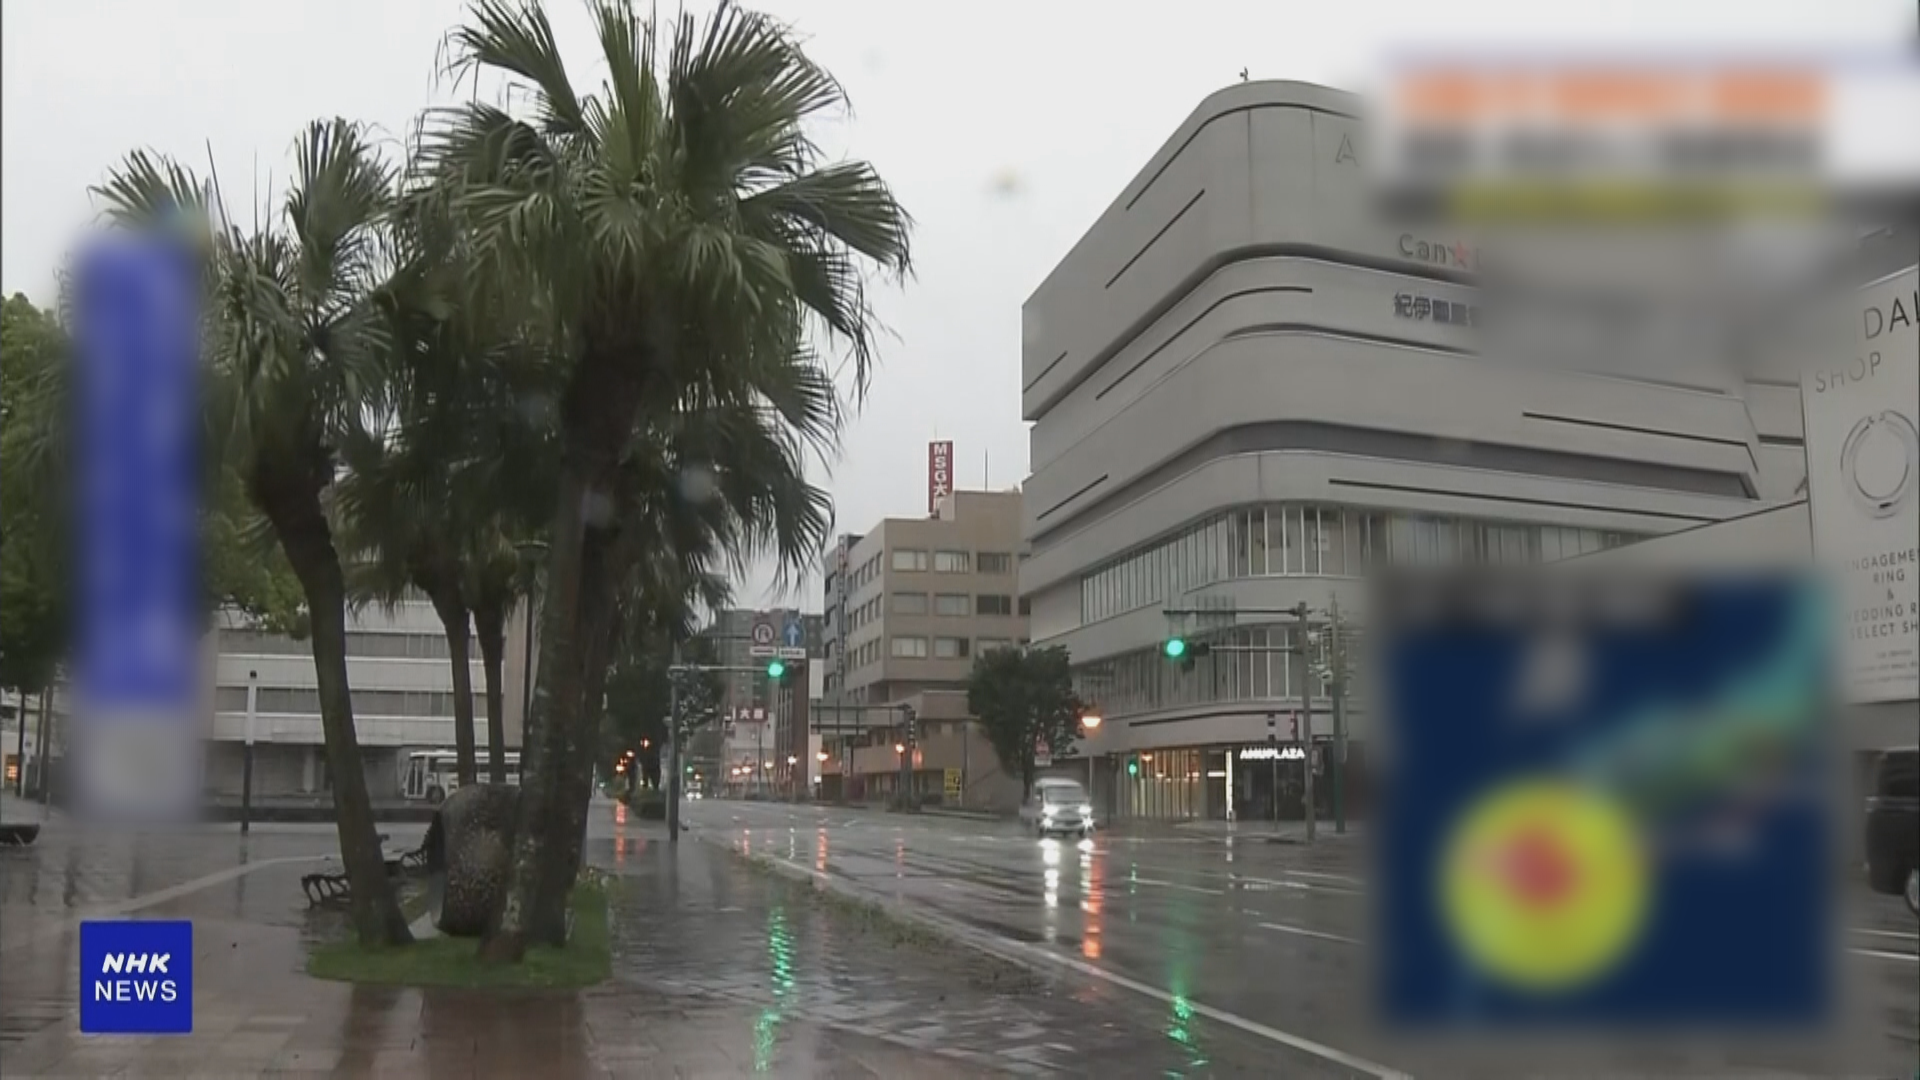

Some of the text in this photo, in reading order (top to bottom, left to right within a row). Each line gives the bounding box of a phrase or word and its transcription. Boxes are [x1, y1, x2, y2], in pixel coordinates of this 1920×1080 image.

[1815, 351, 1881, 393] SHOP
[934, 443, 948, 509] MSG大
[1873, 568, 1905, 584] RING
